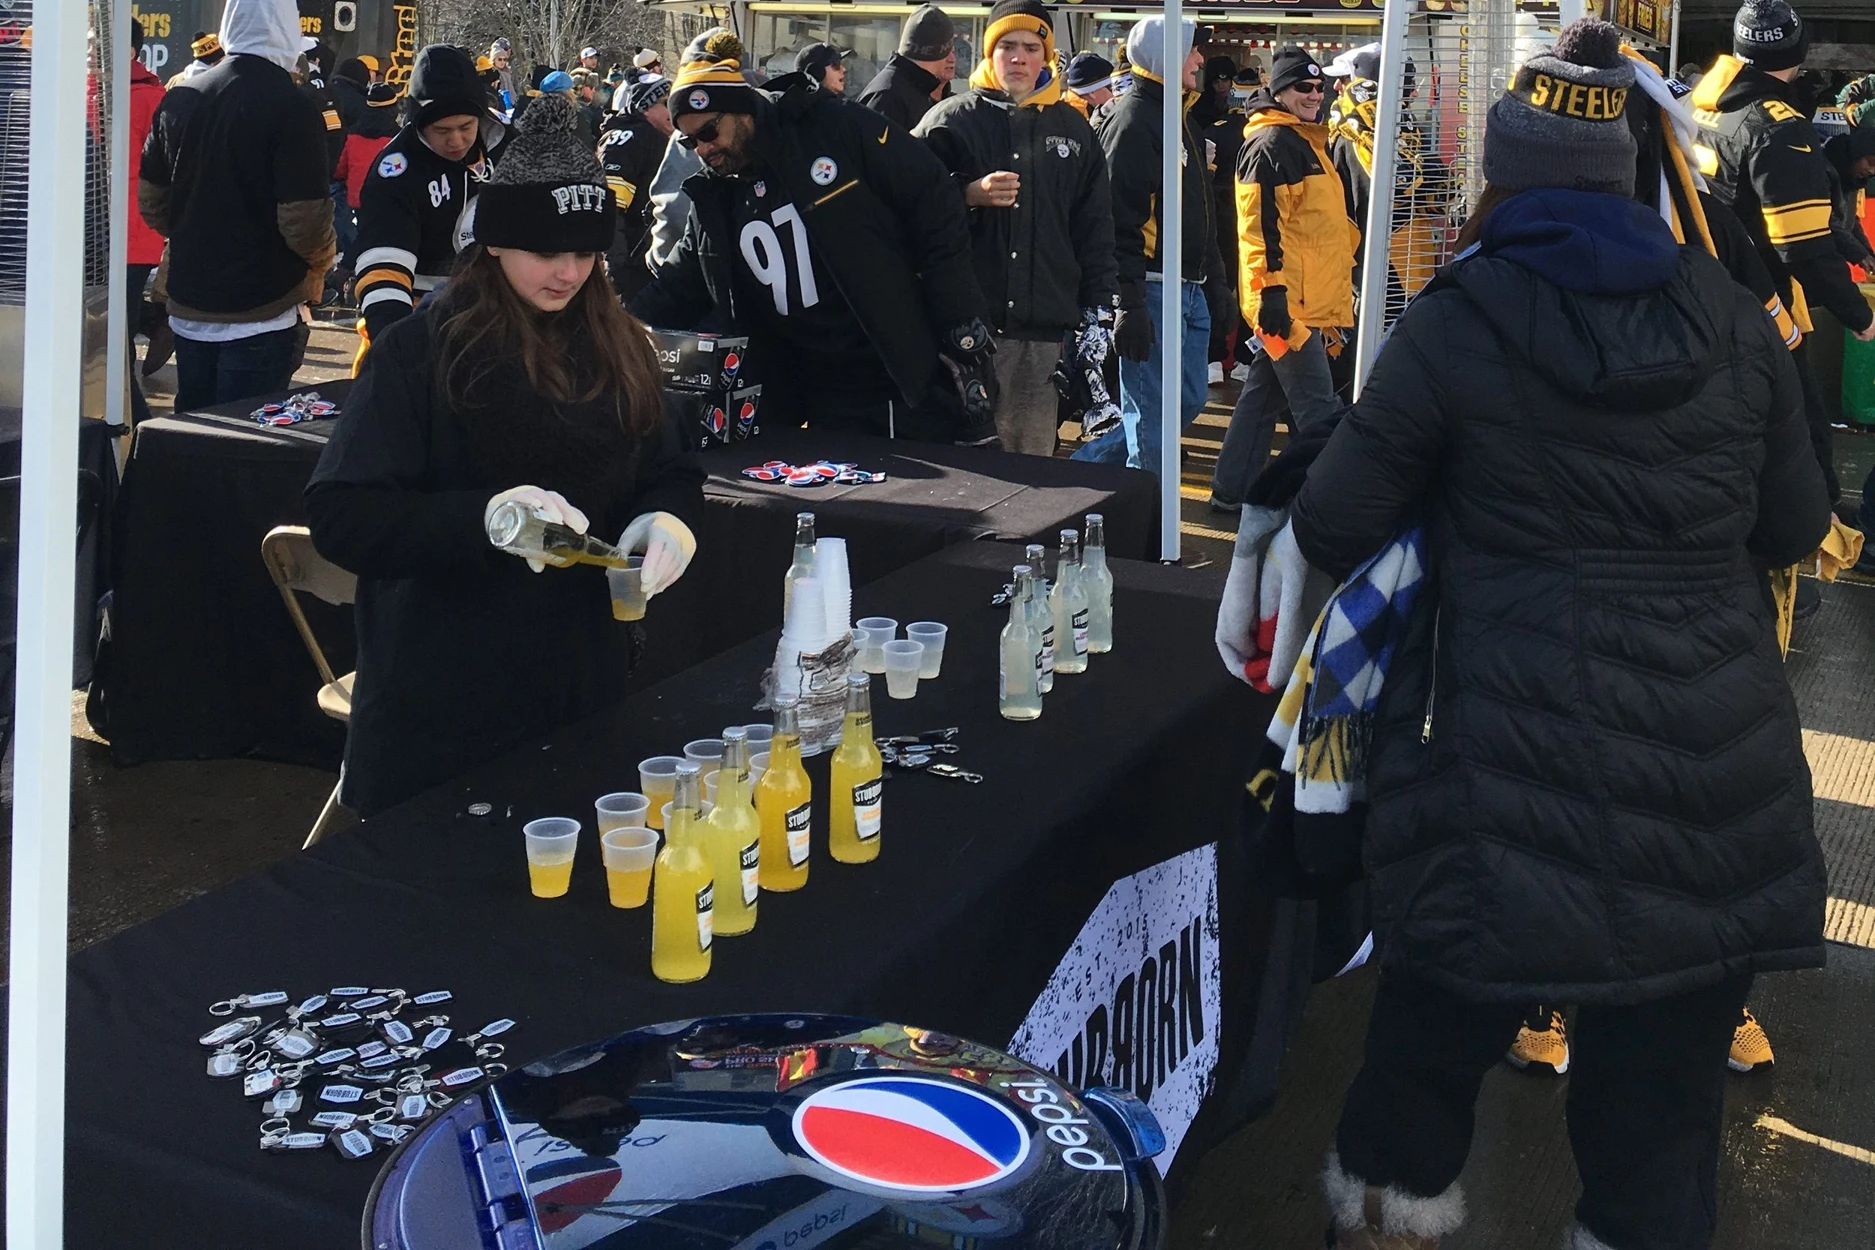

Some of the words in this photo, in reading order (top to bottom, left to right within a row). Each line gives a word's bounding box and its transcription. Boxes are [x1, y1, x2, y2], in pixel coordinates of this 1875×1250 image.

[1820, 111, 1845, 122] STE
[427, 173, 451, 208] 84
[552, 183, 607, 215] PITT
[740, 202, 819, 316] 97
[324, 1088, 359, 1100] STUBBORN
[1000, 1078, 1123, 1172] pepsi
